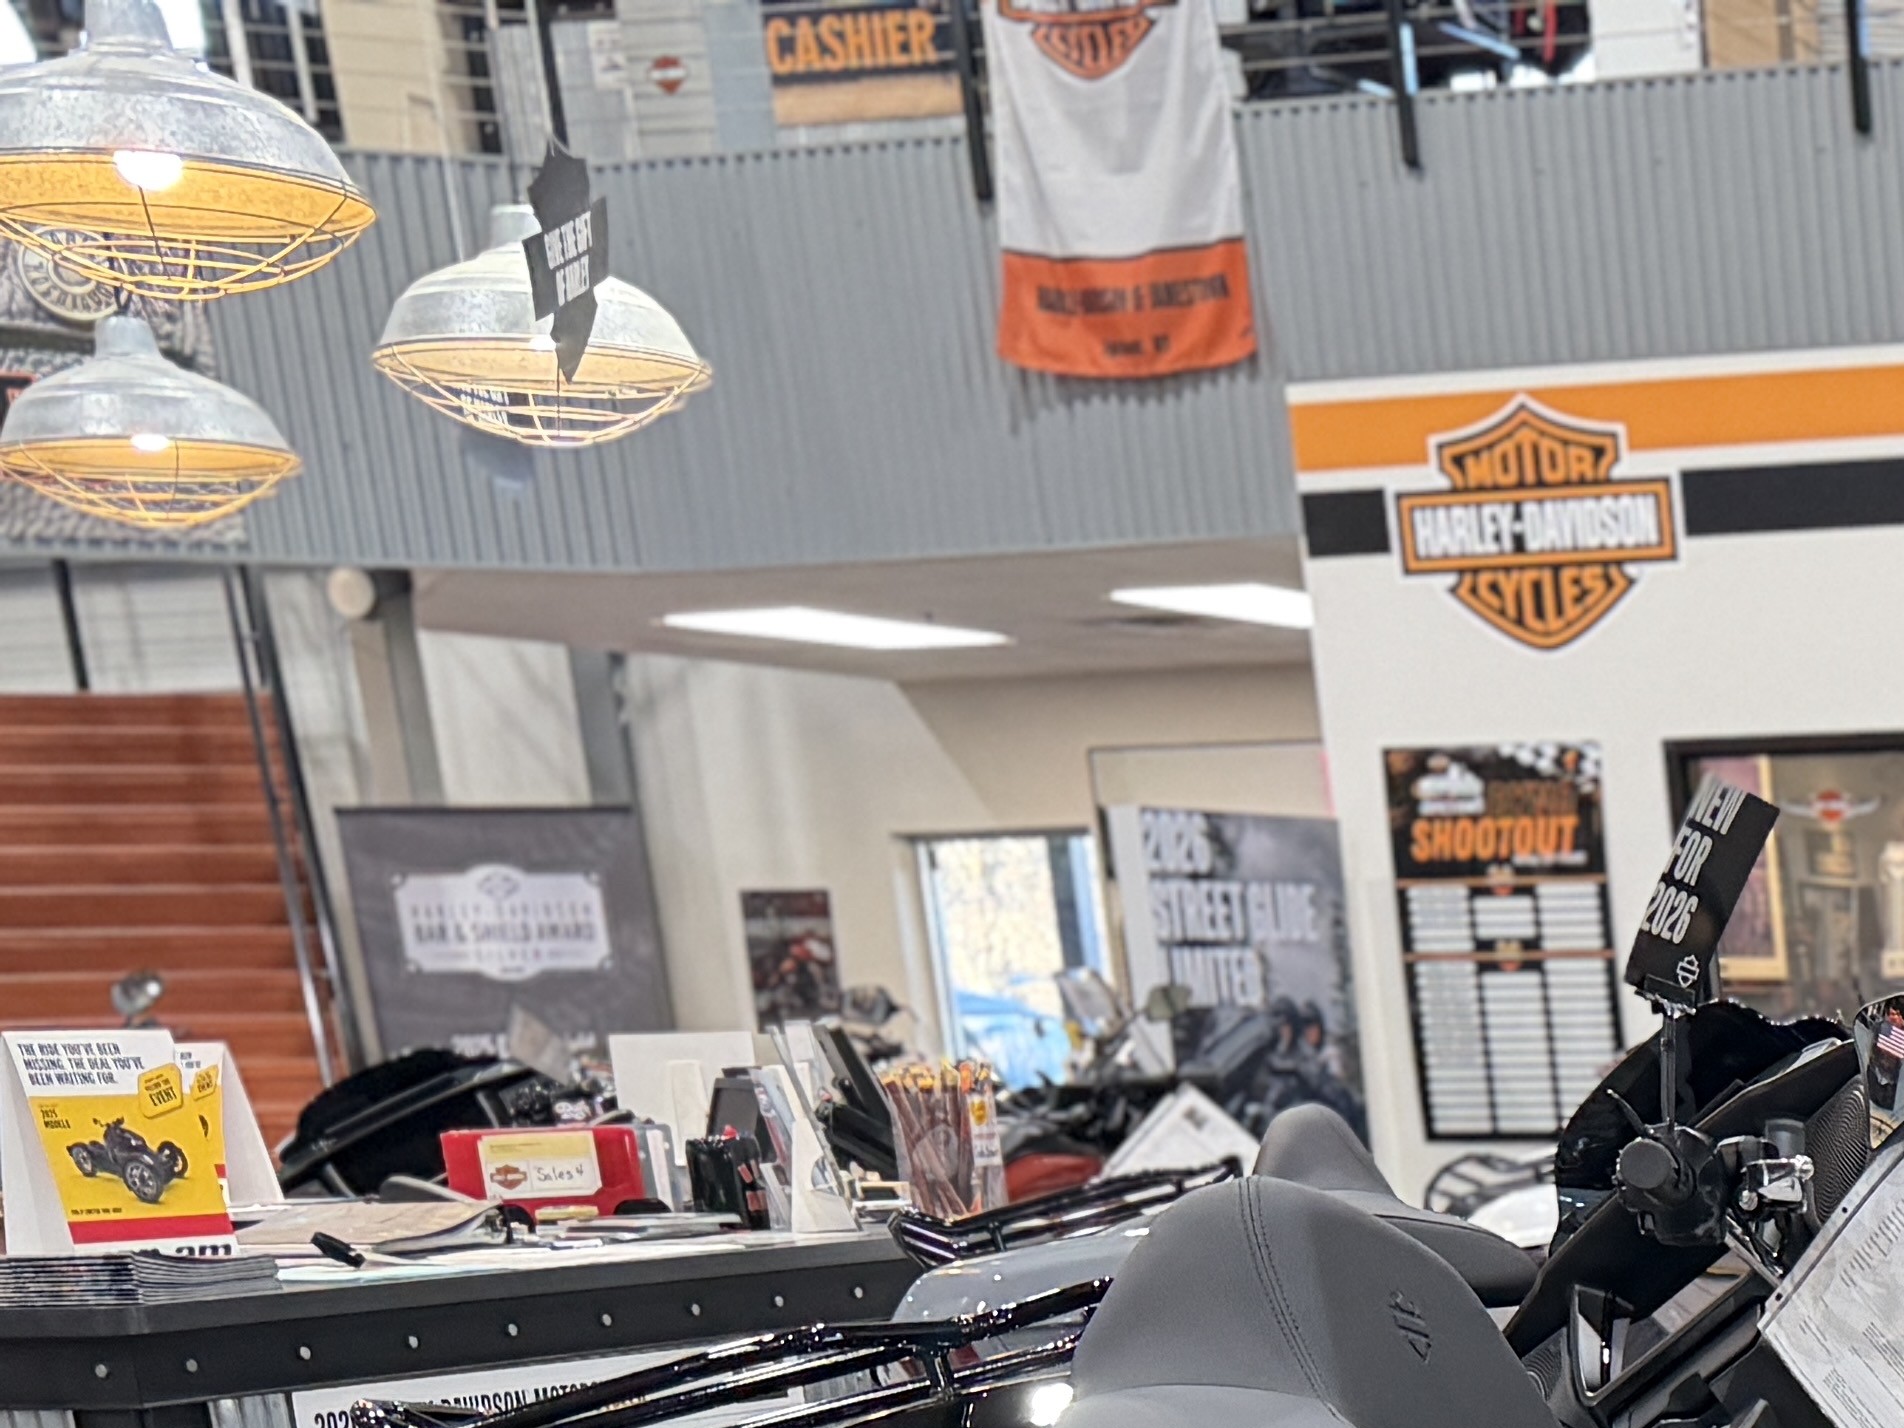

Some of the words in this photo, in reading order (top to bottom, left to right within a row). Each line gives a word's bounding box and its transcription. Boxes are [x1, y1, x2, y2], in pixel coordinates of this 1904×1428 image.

[766, 8, 938, 74] CASHIER
[1464, 428, 1595, 487] MOTOR
[1412, 493, 1662, 559] HARLEY-DAVIDSON
[1476, 565, 1606, 632] CYCLES
[1411, 814, 1580, 863] SHOOTOUT
[1664, 824, 1713, 886] FOR
[1148, 880, 1247, 942] STREET
[1247, 881, 1321, 943] GLIDE
[1640, 881, 1699, 944] 2026
[18, 1043, 36, 1056] THE
[61, 1042, 94, 1056] YOU'VE
[98, 1042, 121, 1056] BEEN
[67, 1057, 88, 1070] THE
[90, 1057, 111, 1070] DEAL
[113, 1055, 145, 1070] YOU'VE
[29, 1072, 54, 1086] BEEN
[56, 1072, 95, 1086] WAITING
[149, 1086, 177, 1107] EVENT
[535, 1165, 574, 1182] Sales
